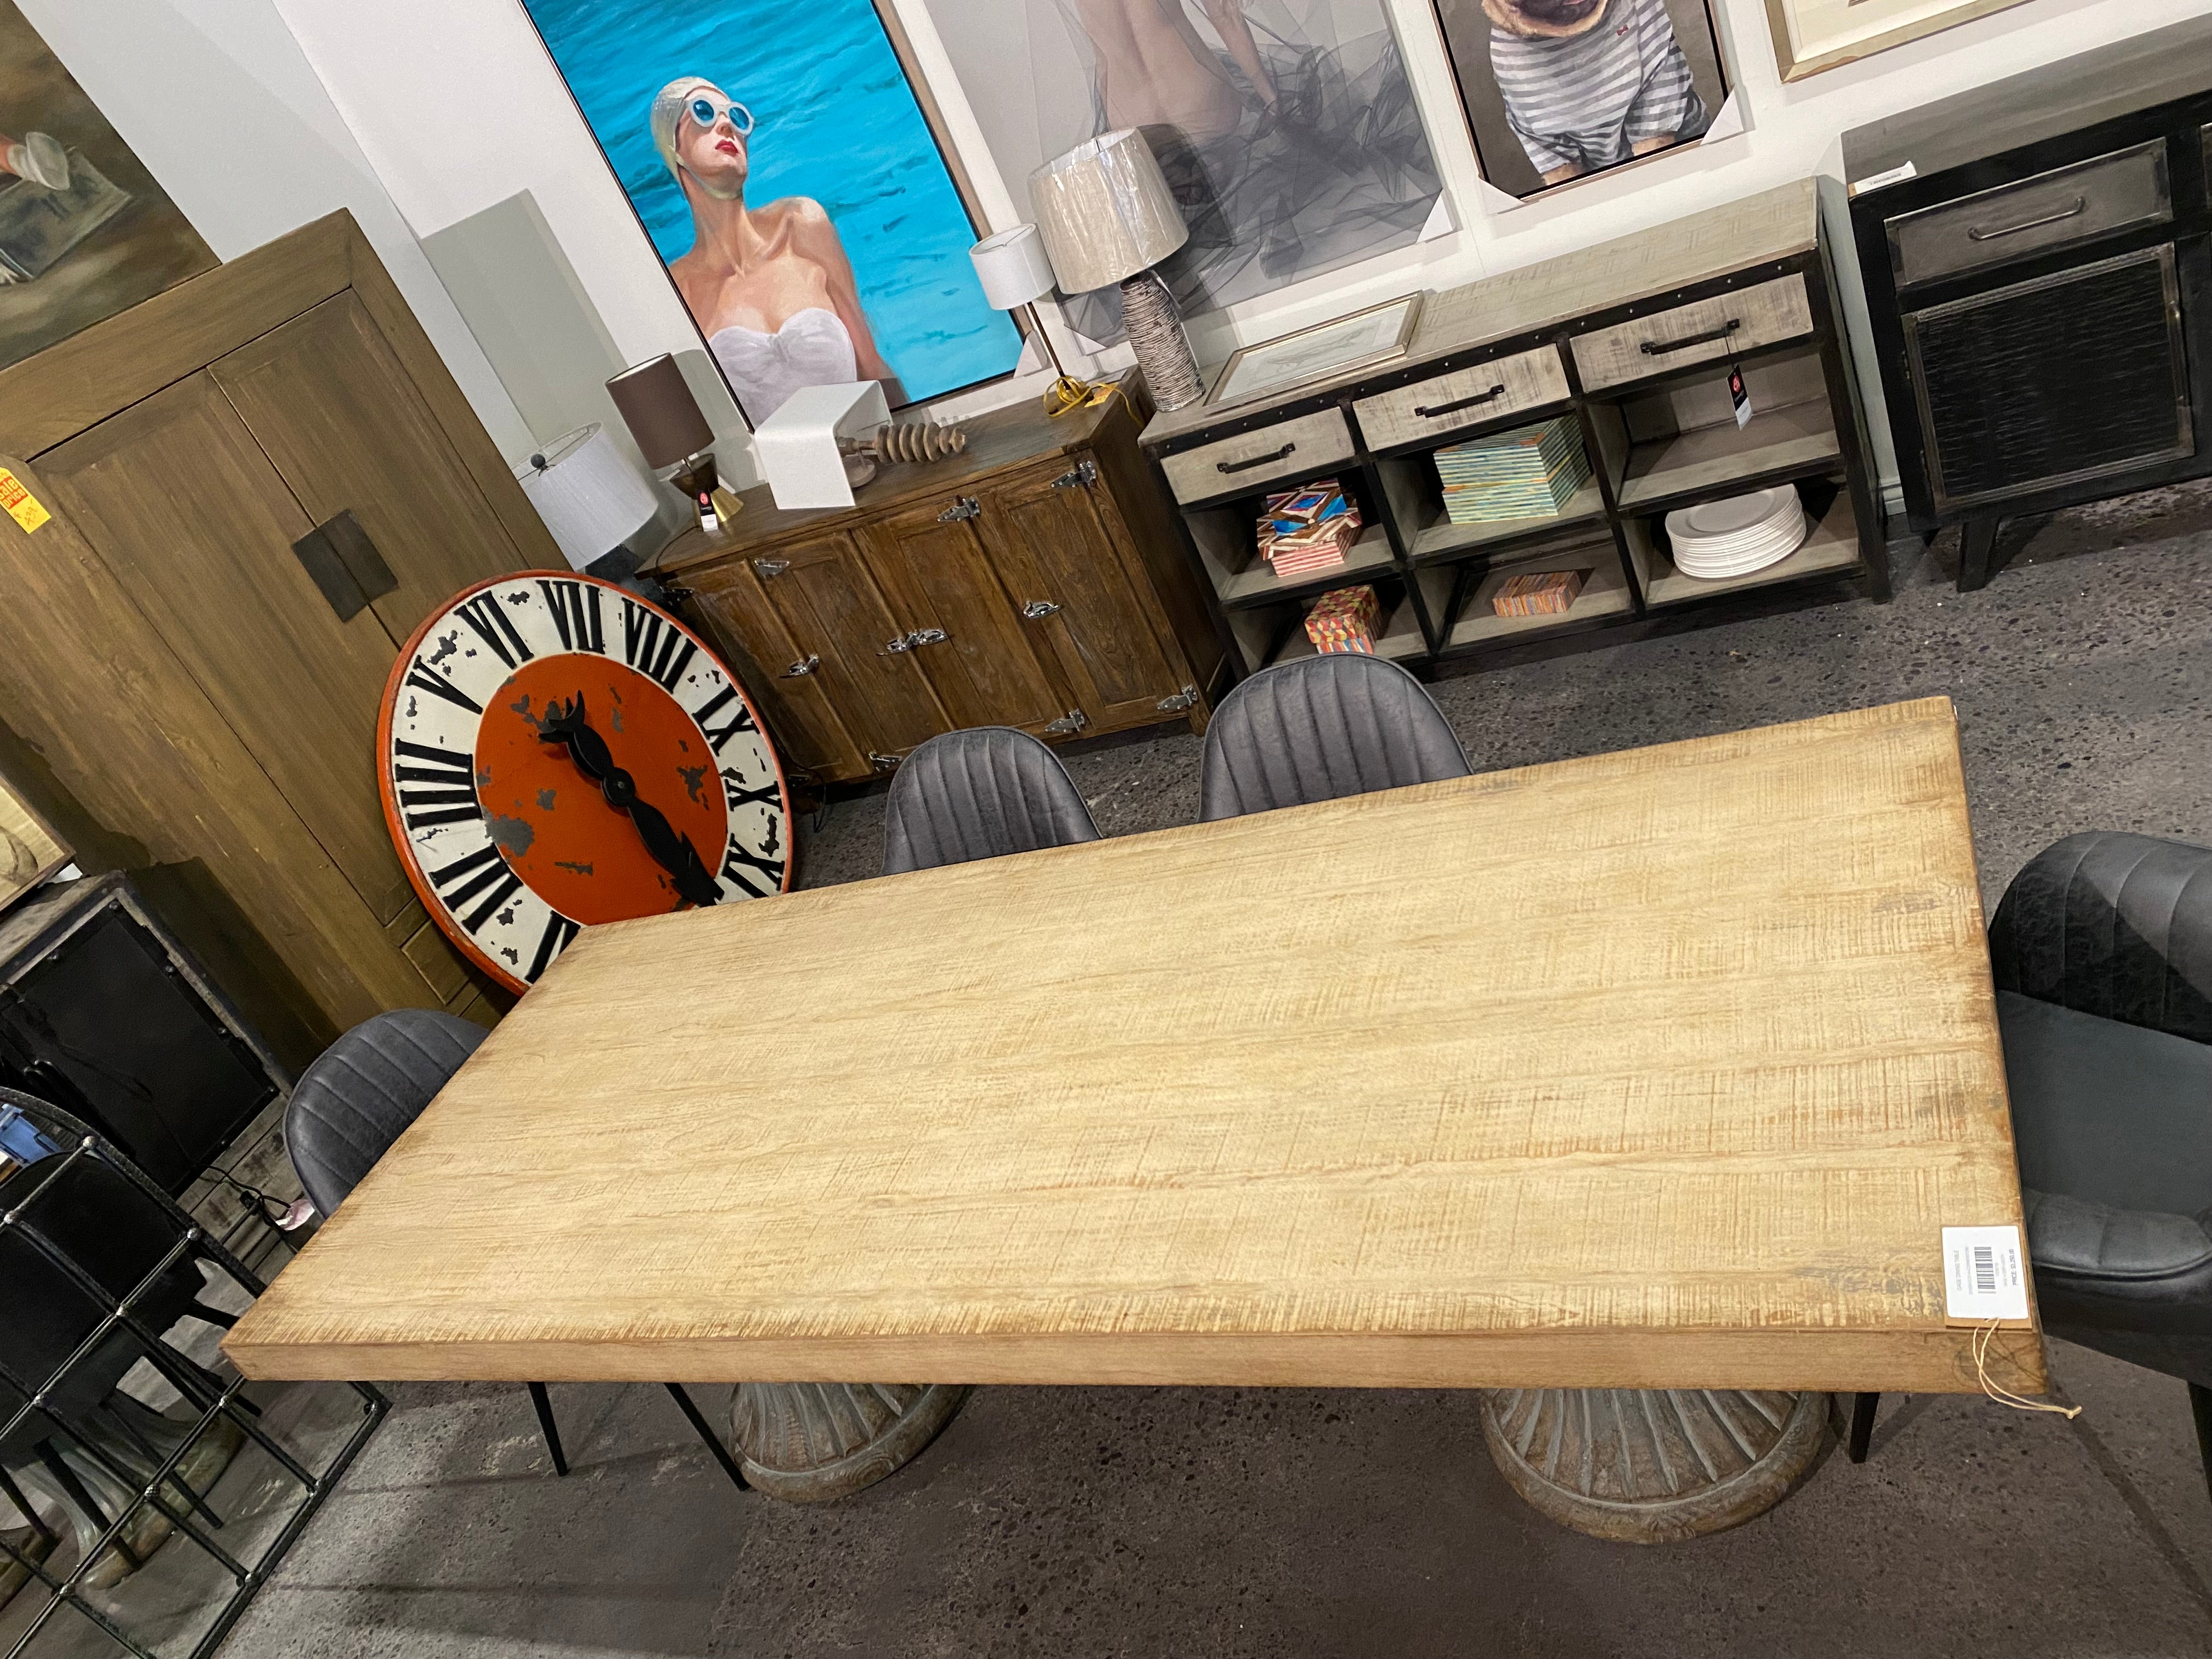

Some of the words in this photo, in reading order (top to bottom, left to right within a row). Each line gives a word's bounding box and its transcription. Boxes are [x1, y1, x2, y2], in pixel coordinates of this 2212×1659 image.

[2, 489, 25, 509] price
[453, 590, 534, 669] VI
[536, 579, 605, 653] VII
[621, 597, 698, 694] VIII
[406, 655, 483, 715] V
[692, 683, 760, 757] IX
[394, 738, 483, 831] IIII
[727, 780, 785, 812] X
[430, 841, 523, 935] III
